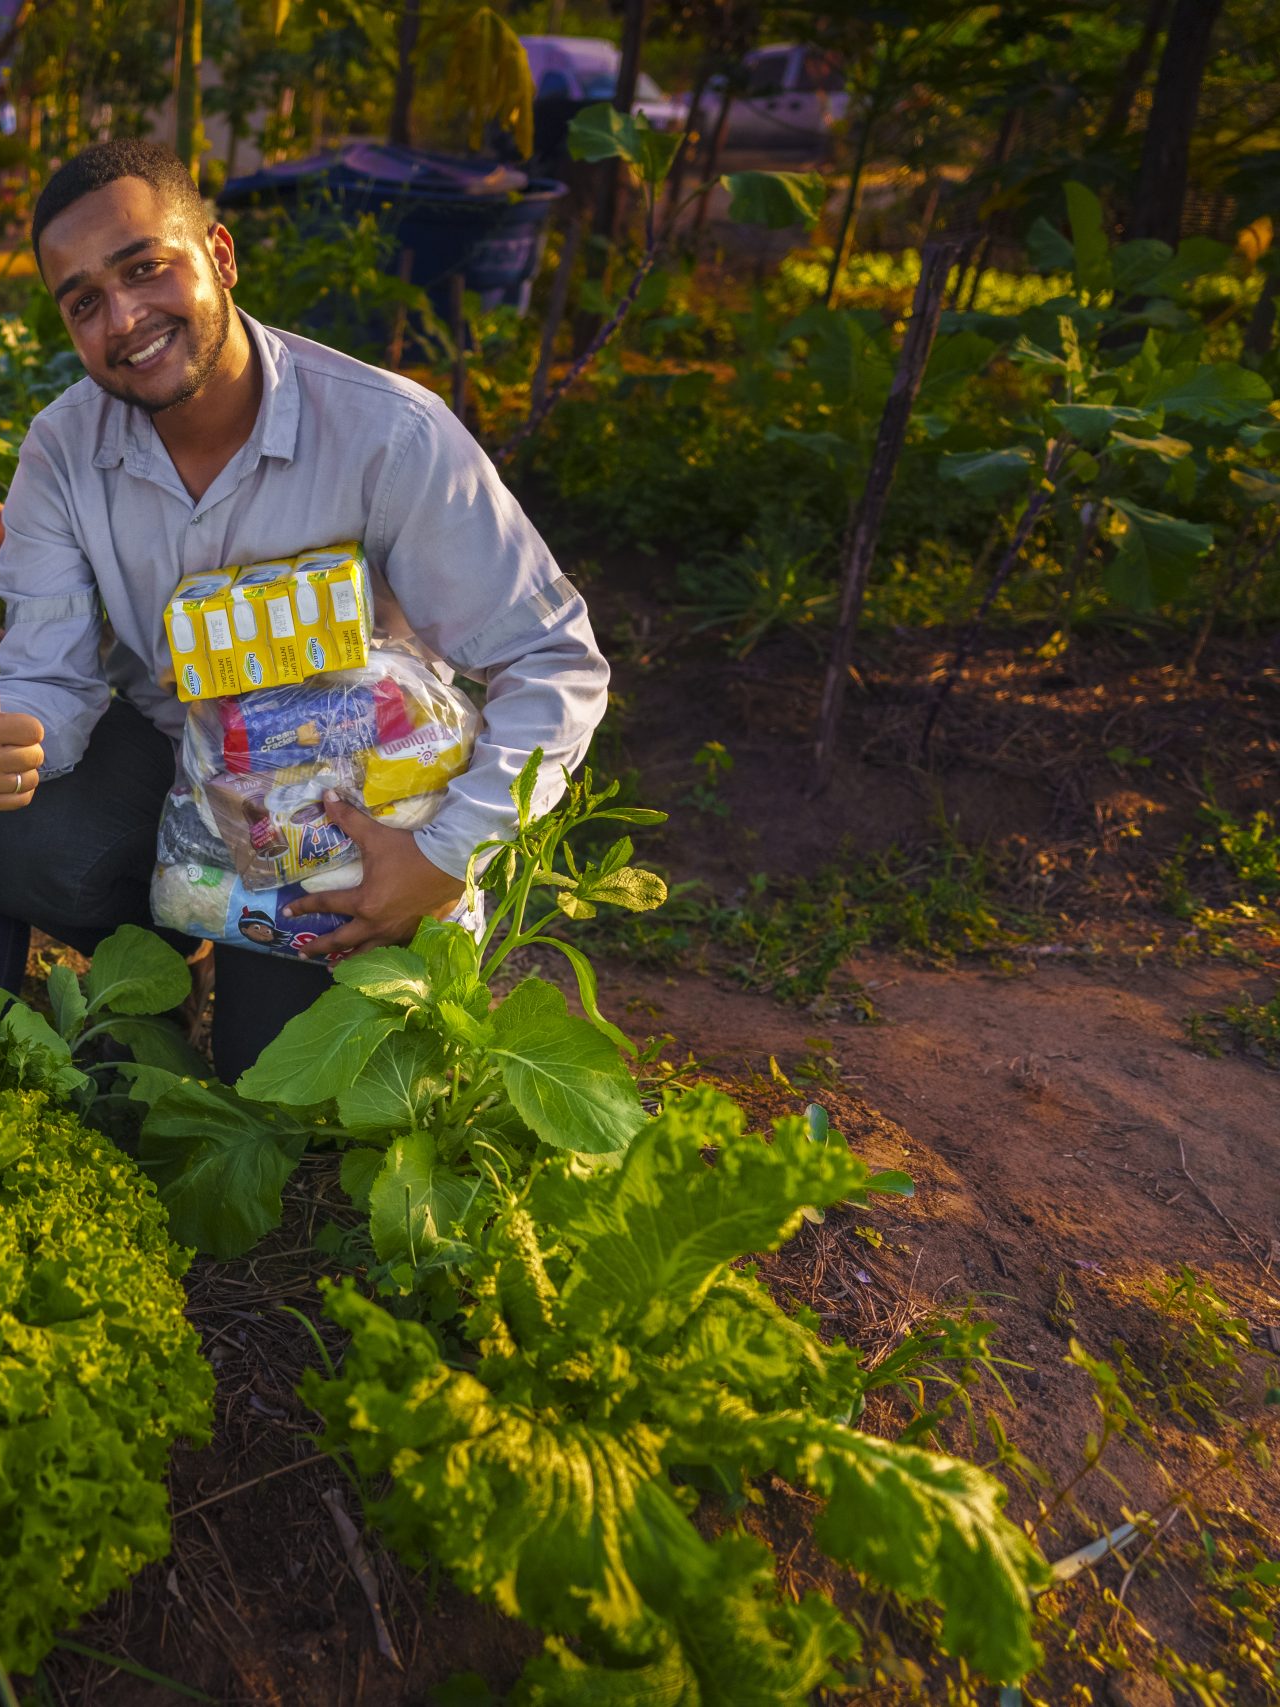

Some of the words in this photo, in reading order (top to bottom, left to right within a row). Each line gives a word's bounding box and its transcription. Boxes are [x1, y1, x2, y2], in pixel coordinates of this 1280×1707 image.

[310, 637, 321, 669] Damare
[342, 630, 353, 662] INTEGRAL
[248, 653, 258, 684] Damare
[260, 735, 298, 753] cracker
[264, 730, 296, 745] cream
